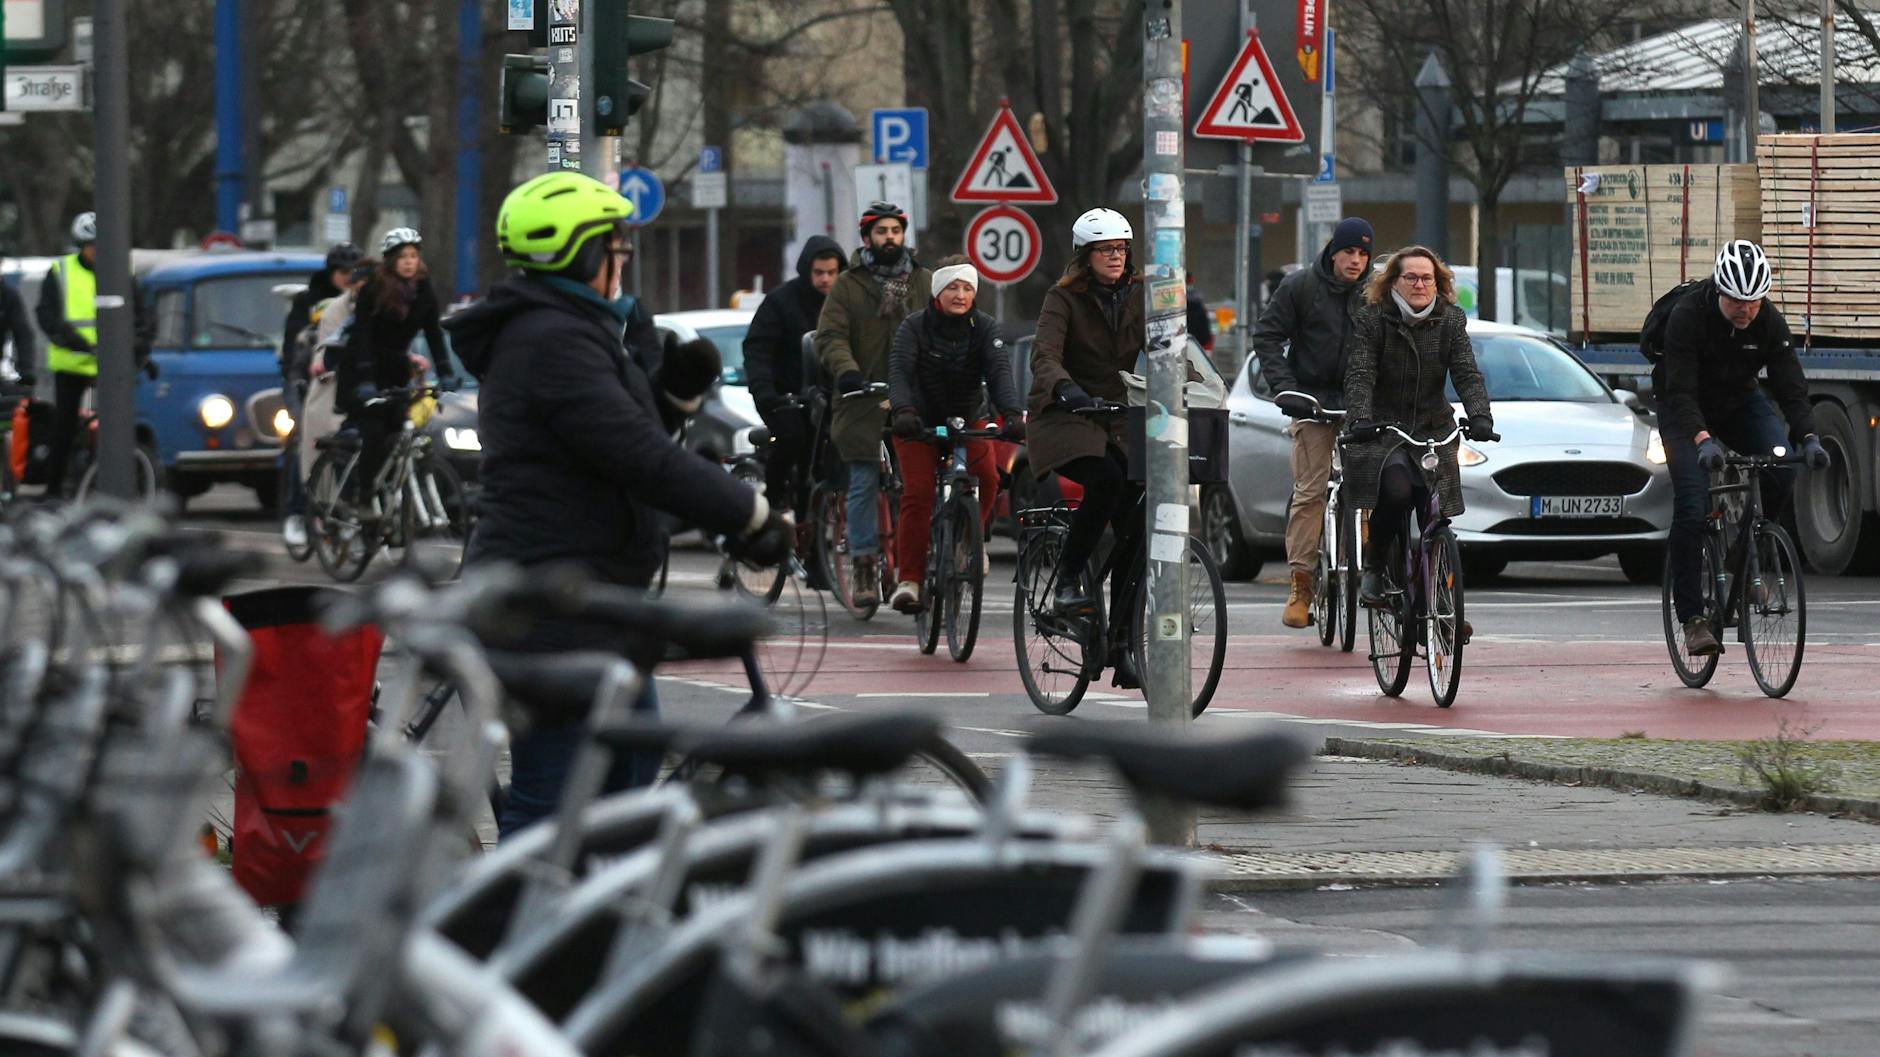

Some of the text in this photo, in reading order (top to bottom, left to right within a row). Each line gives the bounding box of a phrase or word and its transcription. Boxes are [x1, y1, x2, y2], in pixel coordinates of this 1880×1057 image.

[17, 75, 72, 101] Straße
[880, 116, 911, 162] P
[982, 228, 1024, 262] 30
[1541, 498, 1620, 513] M UN 2733
